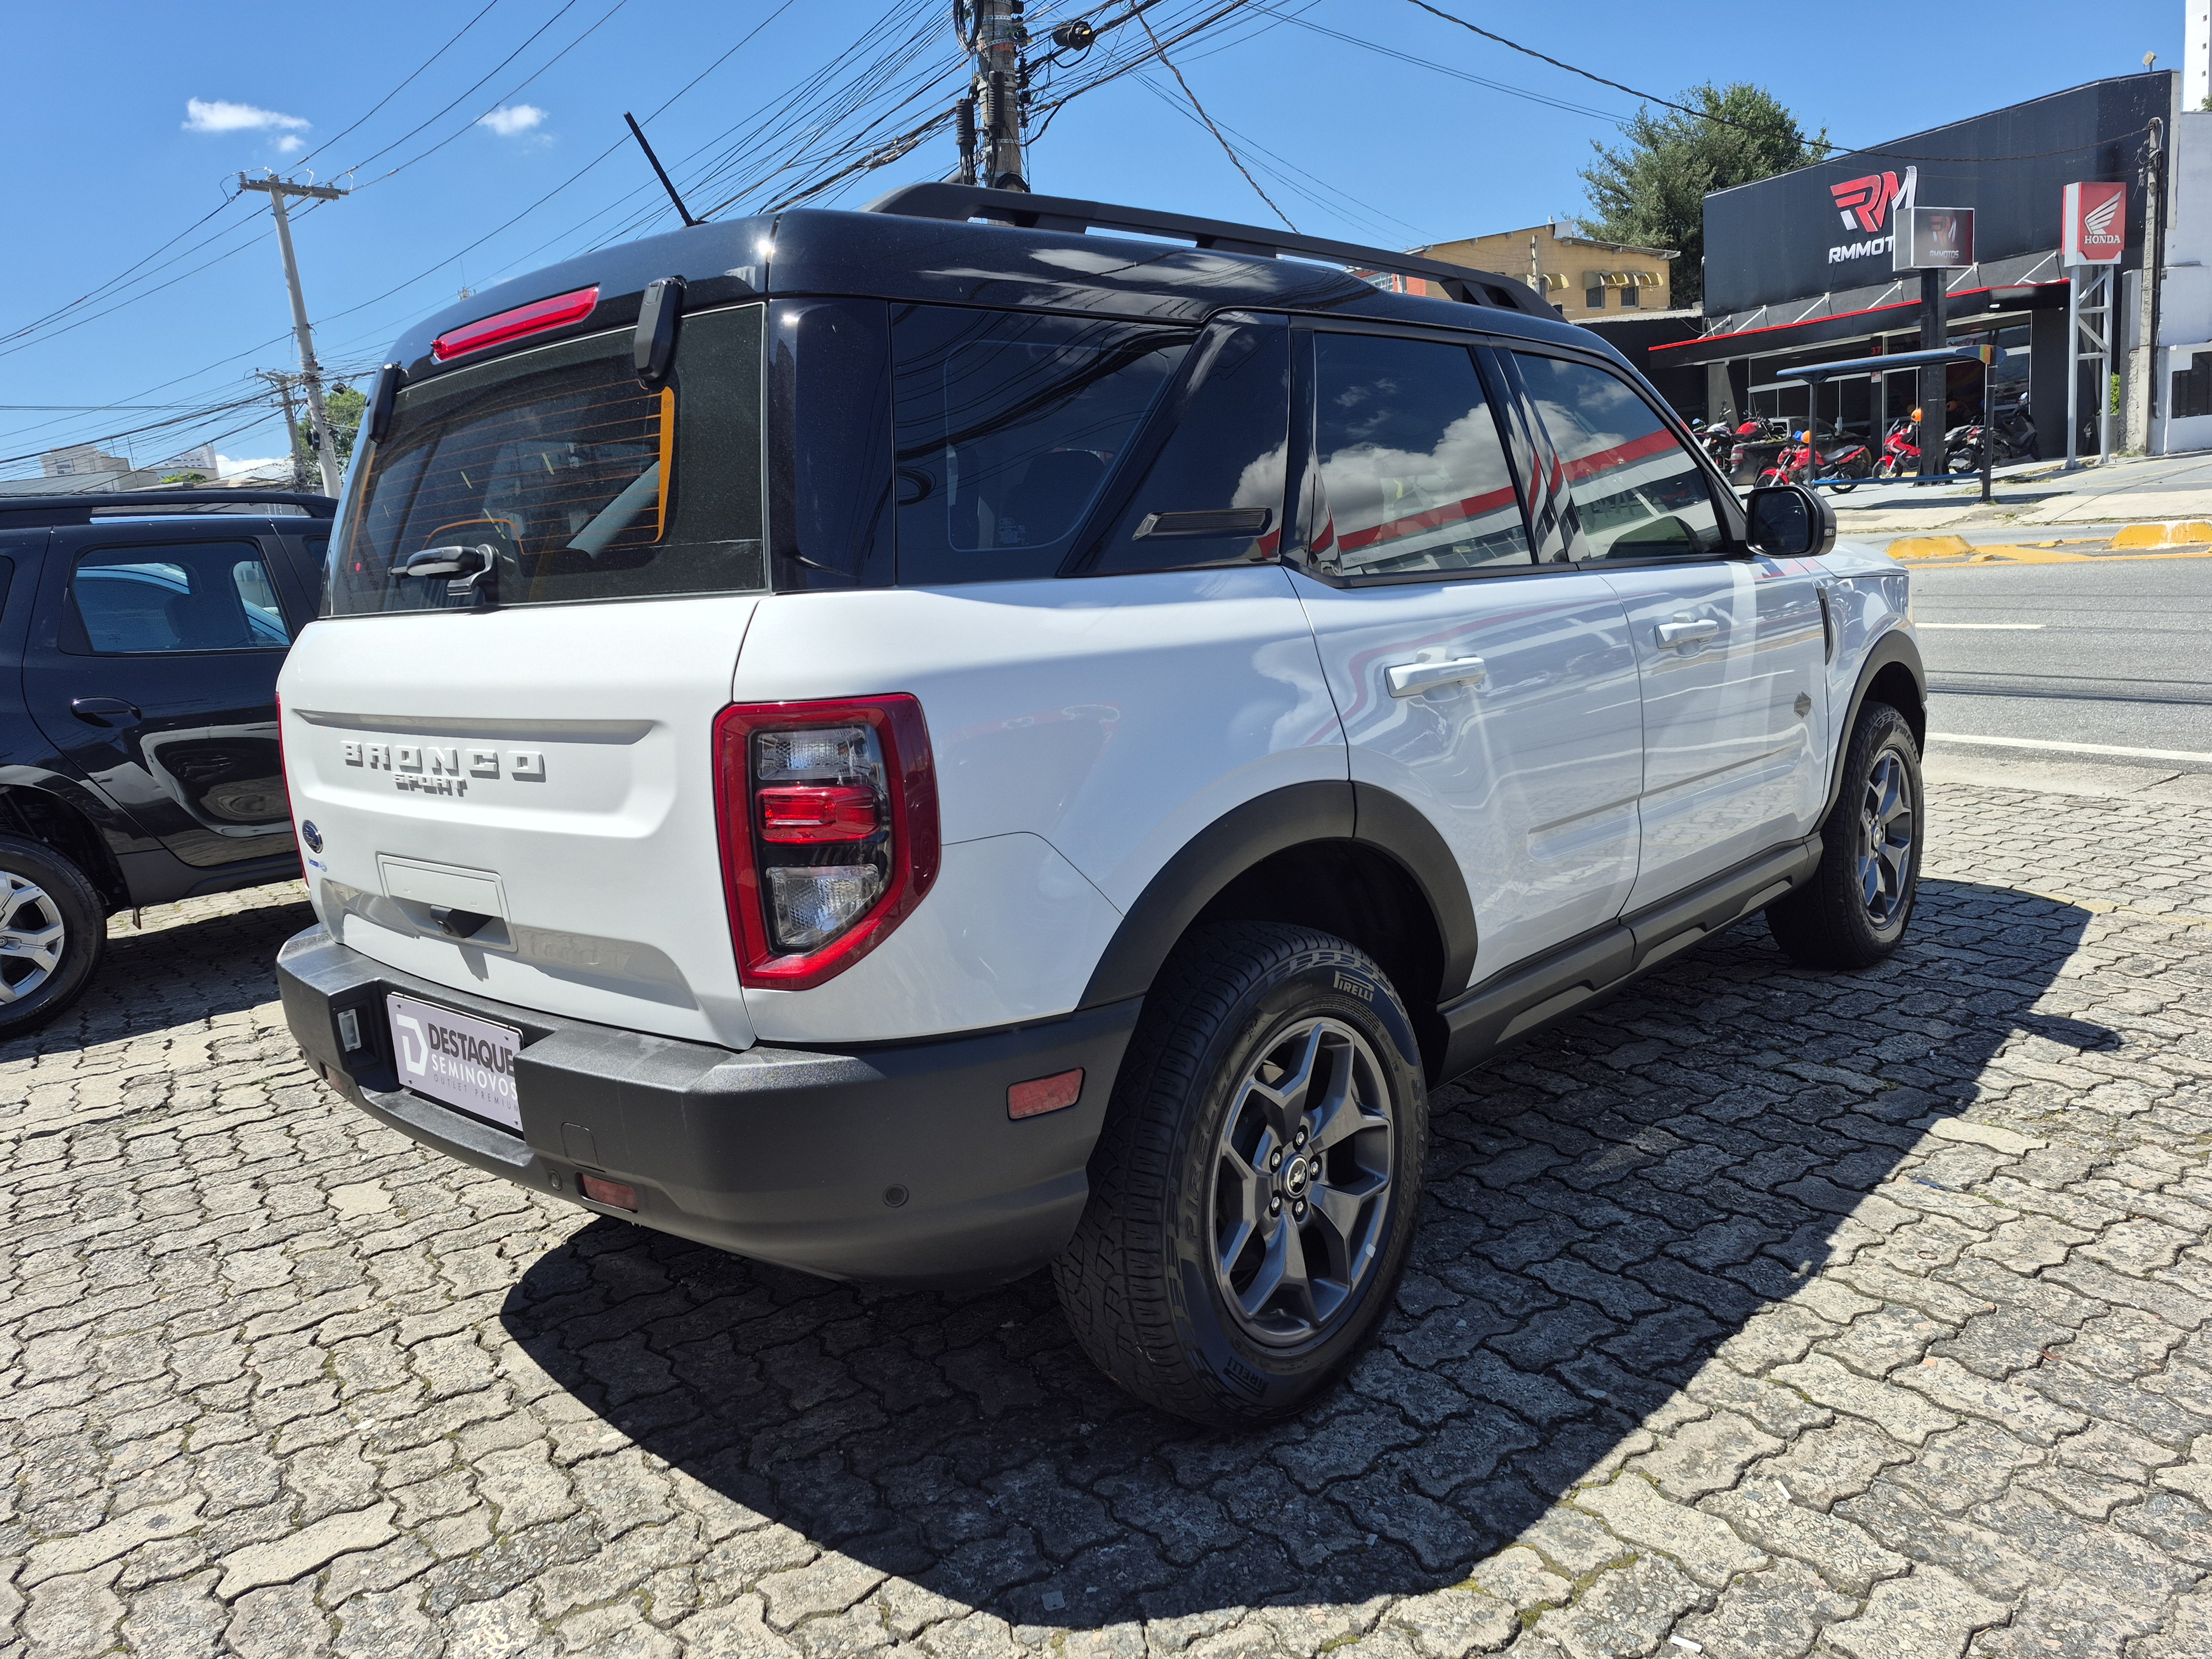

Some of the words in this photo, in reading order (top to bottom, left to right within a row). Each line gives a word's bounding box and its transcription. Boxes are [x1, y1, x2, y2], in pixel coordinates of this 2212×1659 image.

[1828, 235, 1894, 264] RMMOT
[1929, 250, 1959, 259] RMMOTOS
[2084, 234, 2121, 244] HONDA
[1870, 346, 1882, 354] 37
[341, 740, 544, 775] BRONCO
[391, 771, 468, 790] SPORT
[1333, 970, 1375, 1003] PIRELLI
[427, 1022, 515, 1077] DESTAQUE
[431, 1053, 518, 1100] SEMINOVOS
[434, 1074, 468, 1093] OUTLET
[474, 1089, 519, 1113] PREMIUM
[1185, 1057, 1233, 1246] PIRELLI
[1222, 1355, 1269, 1399] PIRELLI
